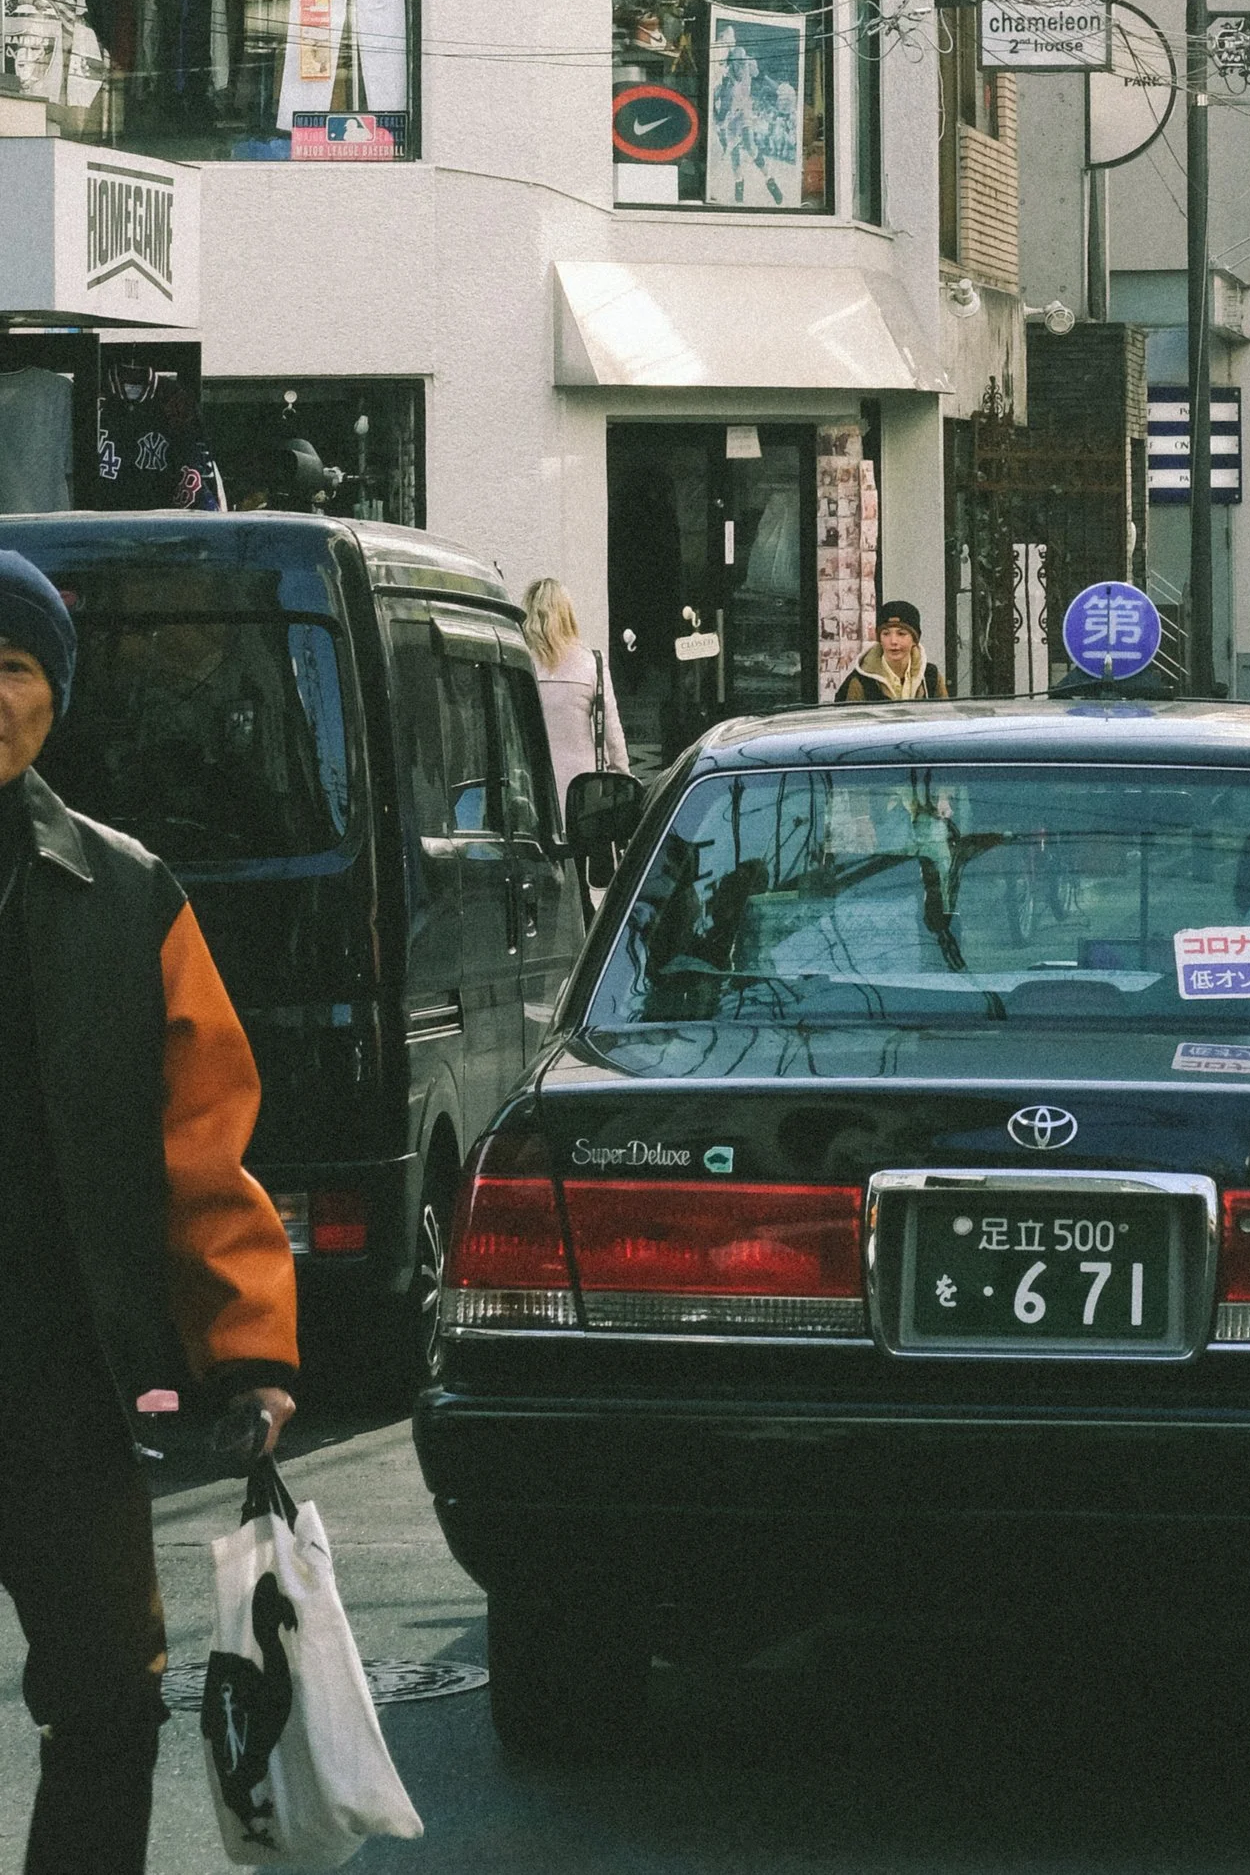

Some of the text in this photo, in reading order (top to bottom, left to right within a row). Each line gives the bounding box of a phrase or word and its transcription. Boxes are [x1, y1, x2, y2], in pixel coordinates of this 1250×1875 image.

[989, 11, 1101, 33] chameleon
[1034, 41, 1084, 54] house
[295, 146, 404, 156] MAJOR LEAGUE BASEBALL
[87, 177, 173, 285] HOMEGAME
[572, 1138, 691, 1171] Super Deluxe
[979, 1218, 1114, 1252] 足立 500
[935, 1274, 957, 1307] を
